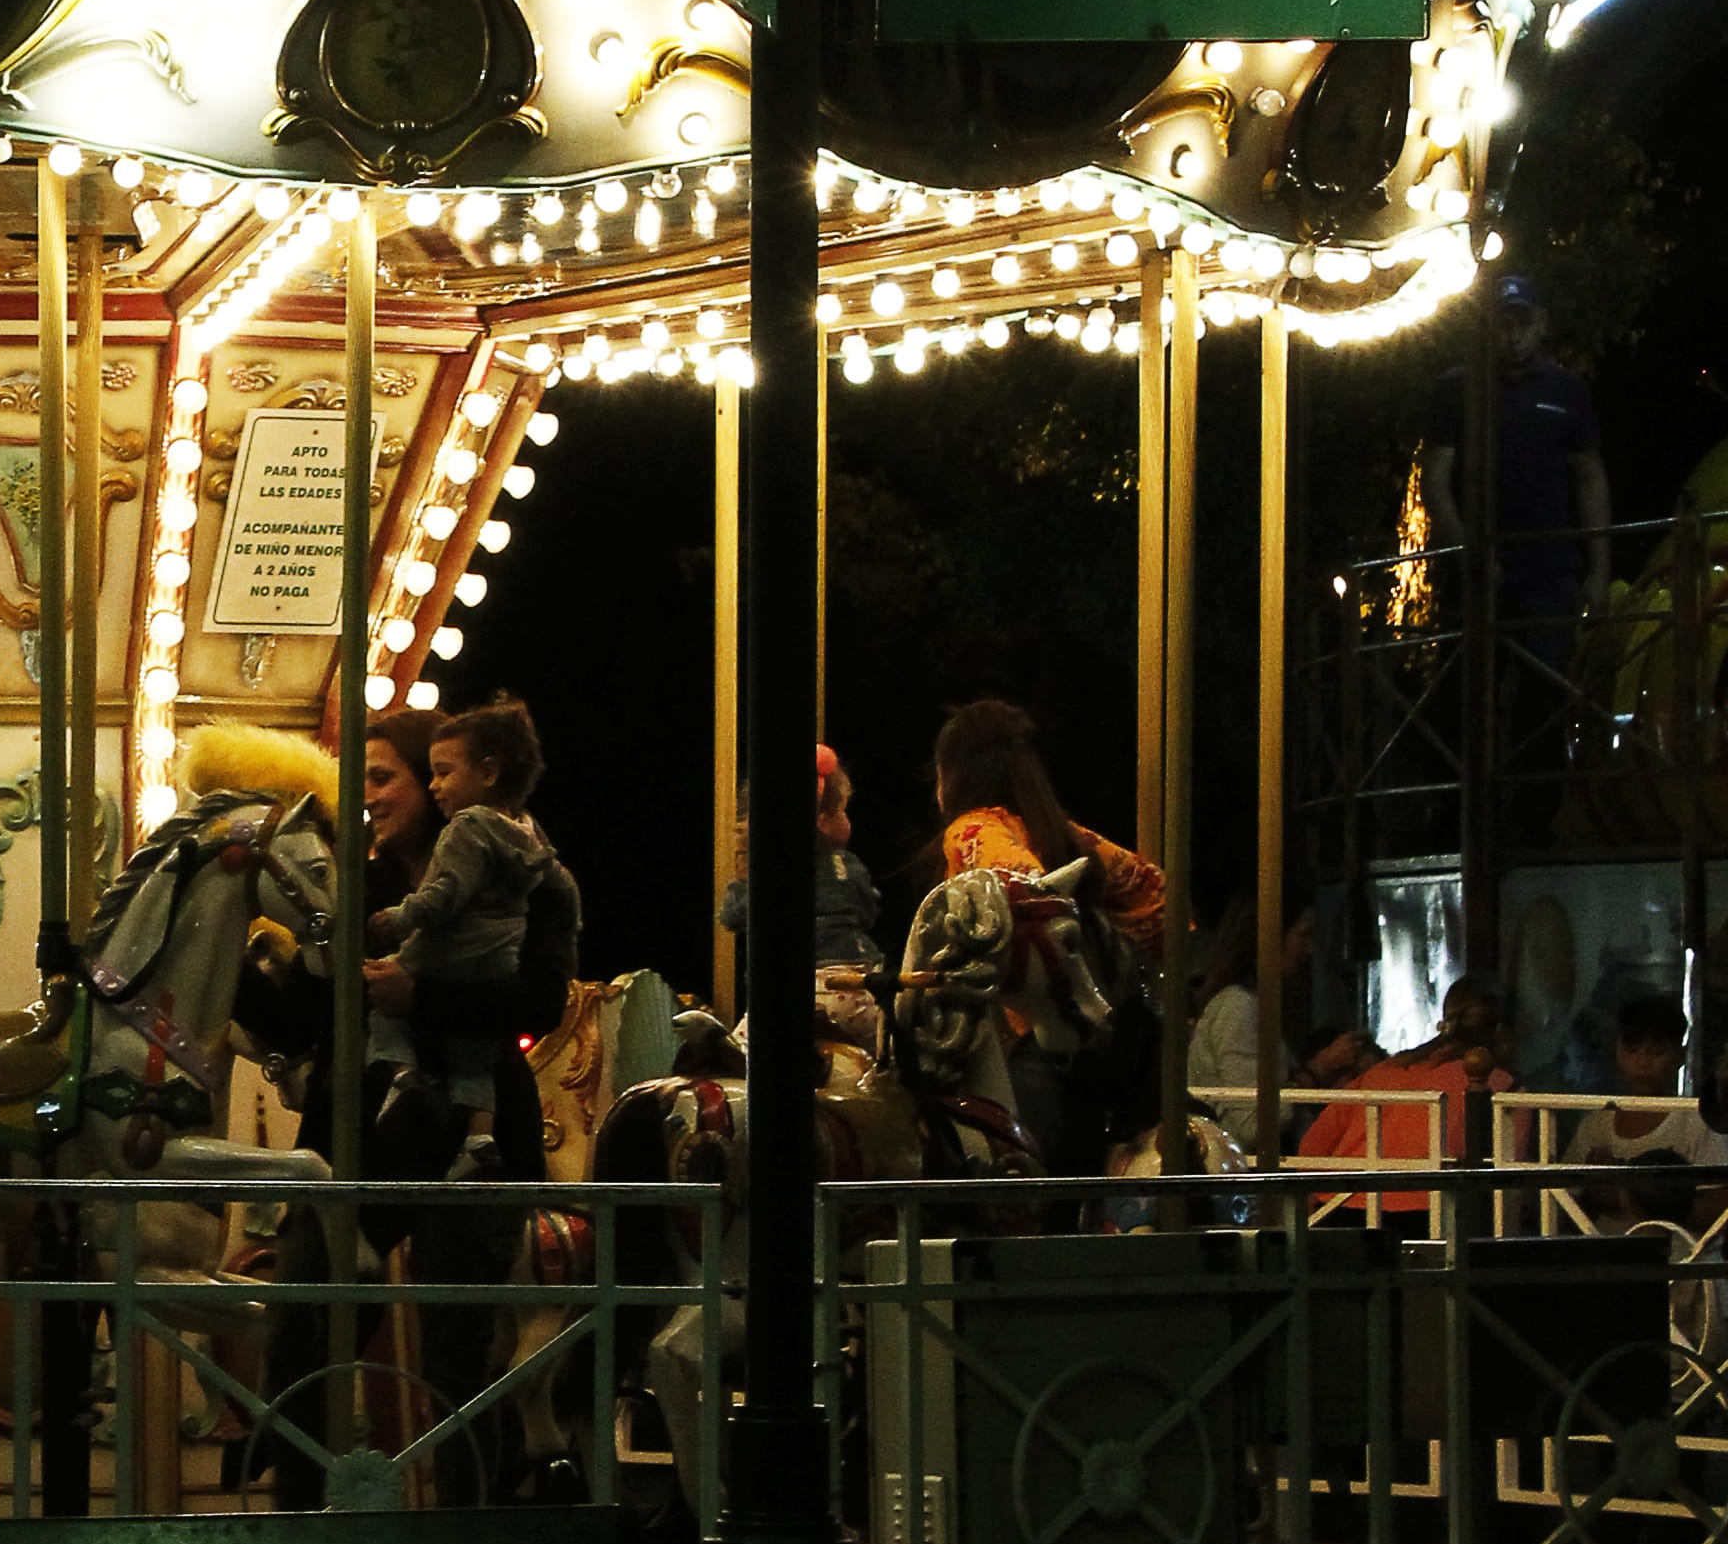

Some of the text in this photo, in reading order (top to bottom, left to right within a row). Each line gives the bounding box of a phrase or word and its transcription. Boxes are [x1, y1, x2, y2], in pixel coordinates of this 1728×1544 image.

[291, 446, 328, 458] APTO
[264, 465, 346, 479] PARA TODAS
[260, 486, 342, 499] LAS EDADES
[234, 544, 252, 556] DE
[294, 545, 343, 557] MENOR
[253, 562, 316, 577] A 2 AÑOS
[250, 586, 310, 598] NO PAGA
